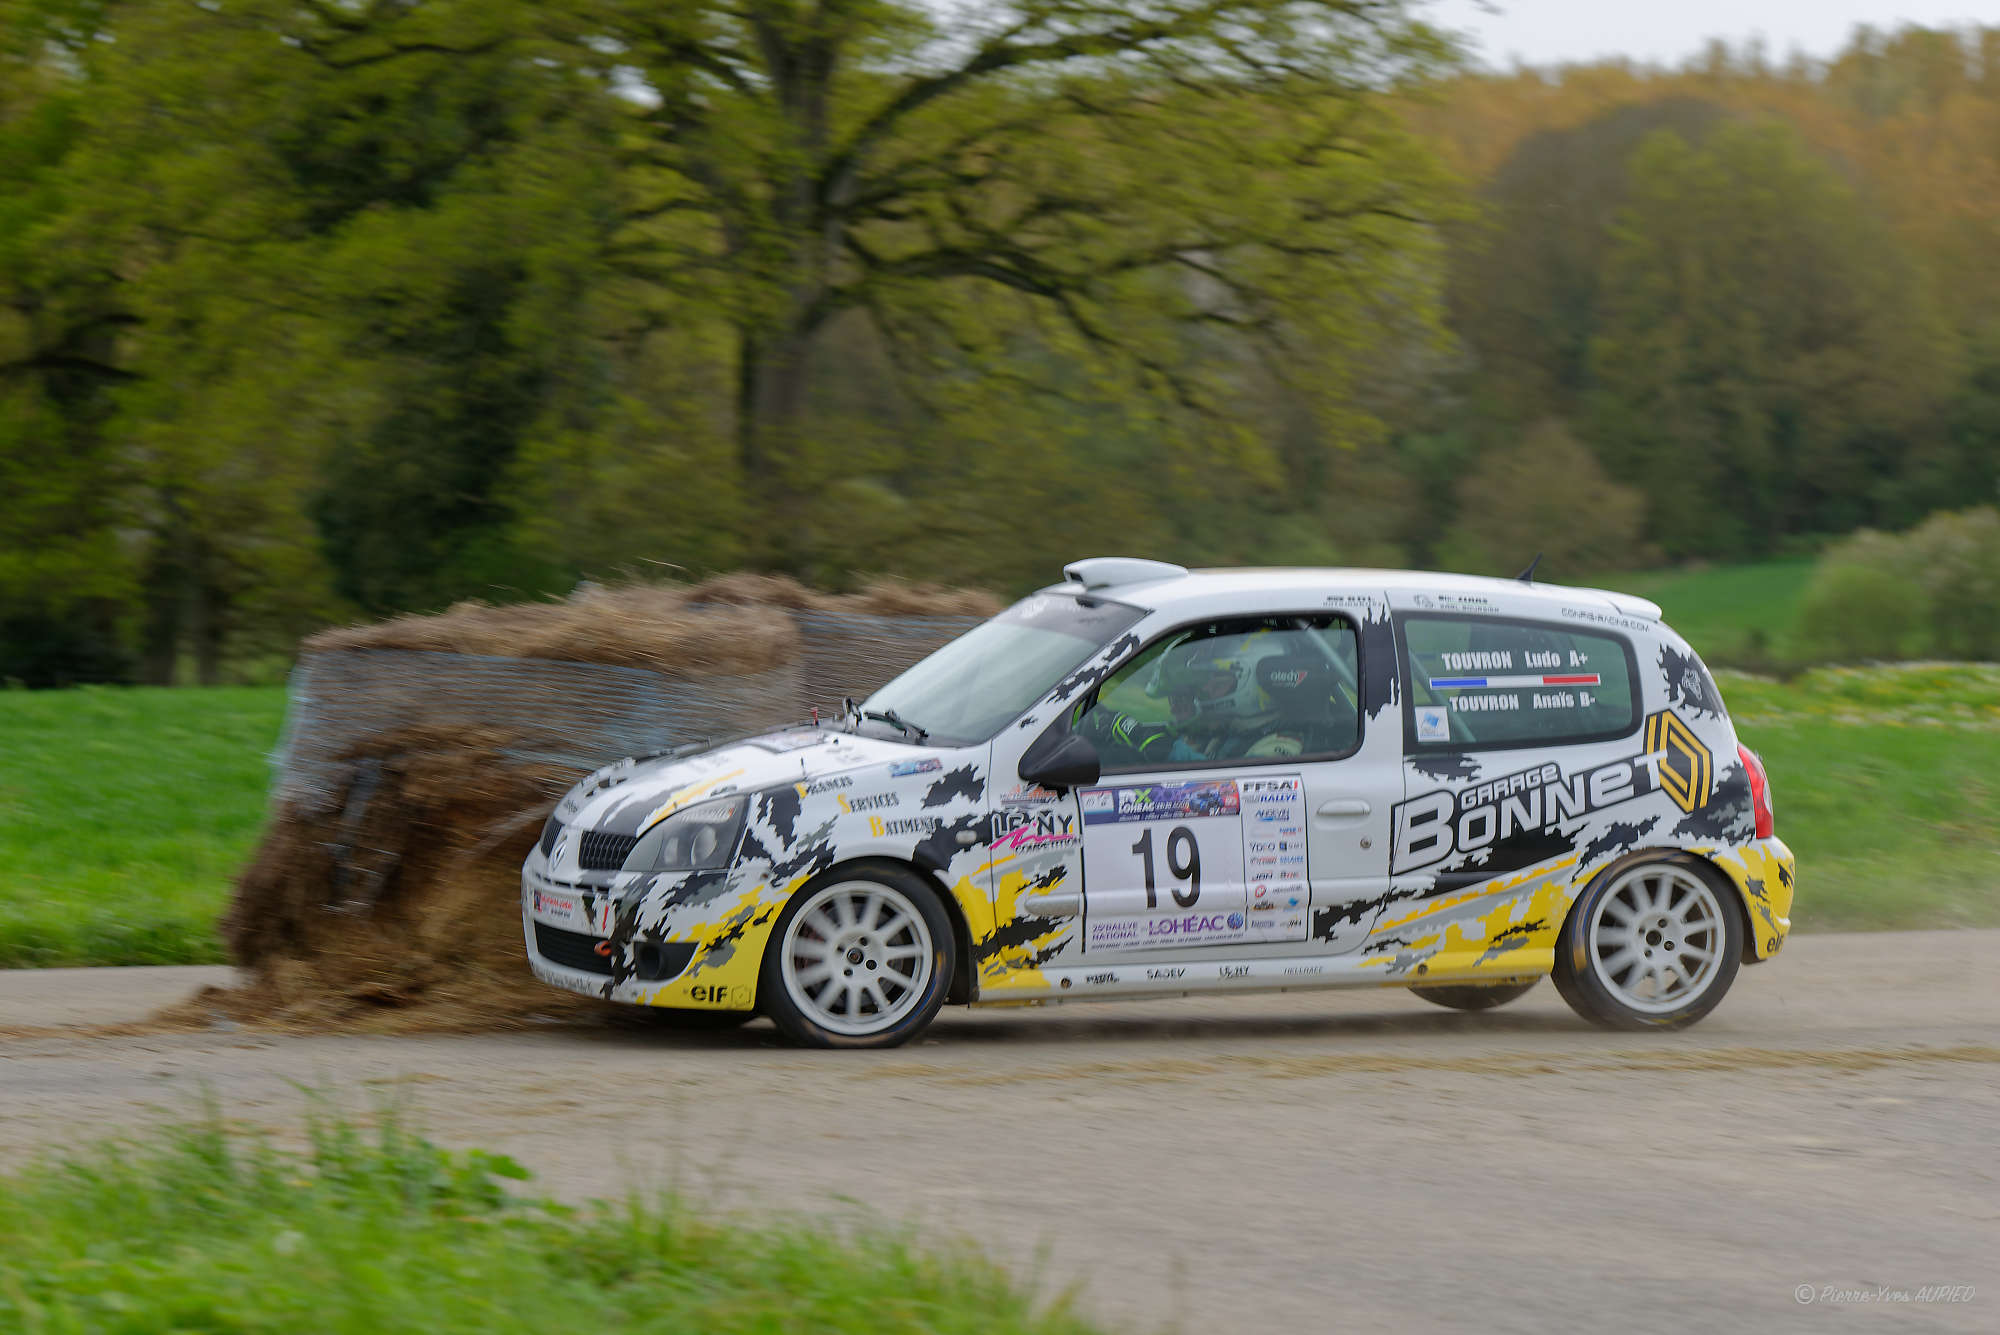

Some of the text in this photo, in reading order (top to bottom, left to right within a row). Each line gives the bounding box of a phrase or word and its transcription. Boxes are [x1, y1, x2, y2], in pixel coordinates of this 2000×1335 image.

[1442, 650, 1588, 671] TOUVRON Ludo A+
[1450, 690, 1596, 712] TOUVRON Anaïs B-
[1131, 826, 1201, 908] 19
[1148, 914, 1225, 936] LOHÉAC
